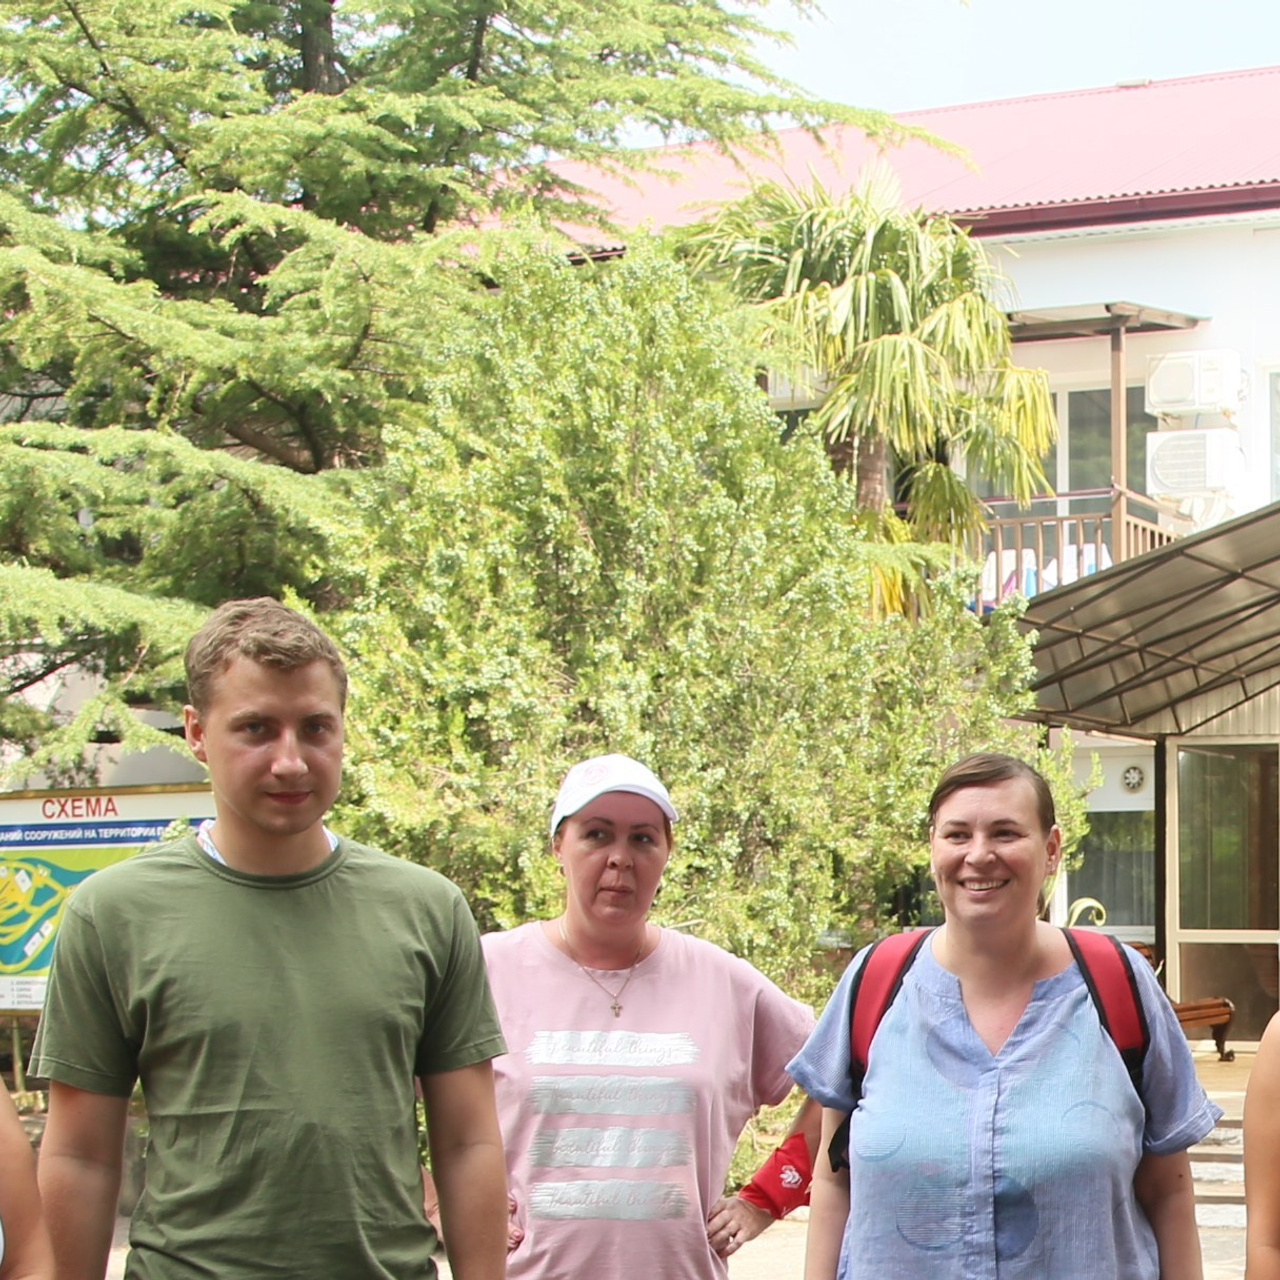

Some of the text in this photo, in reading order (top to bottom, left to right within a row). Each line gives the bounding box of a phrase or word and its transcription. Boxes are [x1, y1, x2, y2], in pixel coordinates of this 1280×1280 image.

[42, 796, 118, 819] СХЕМА
[24, 827, 83, 841] СООРУЖЕНИЙ
[84, 828, 97, 839] НА
[98, 827, 156, 839] ТЕРРИТОРИИ
